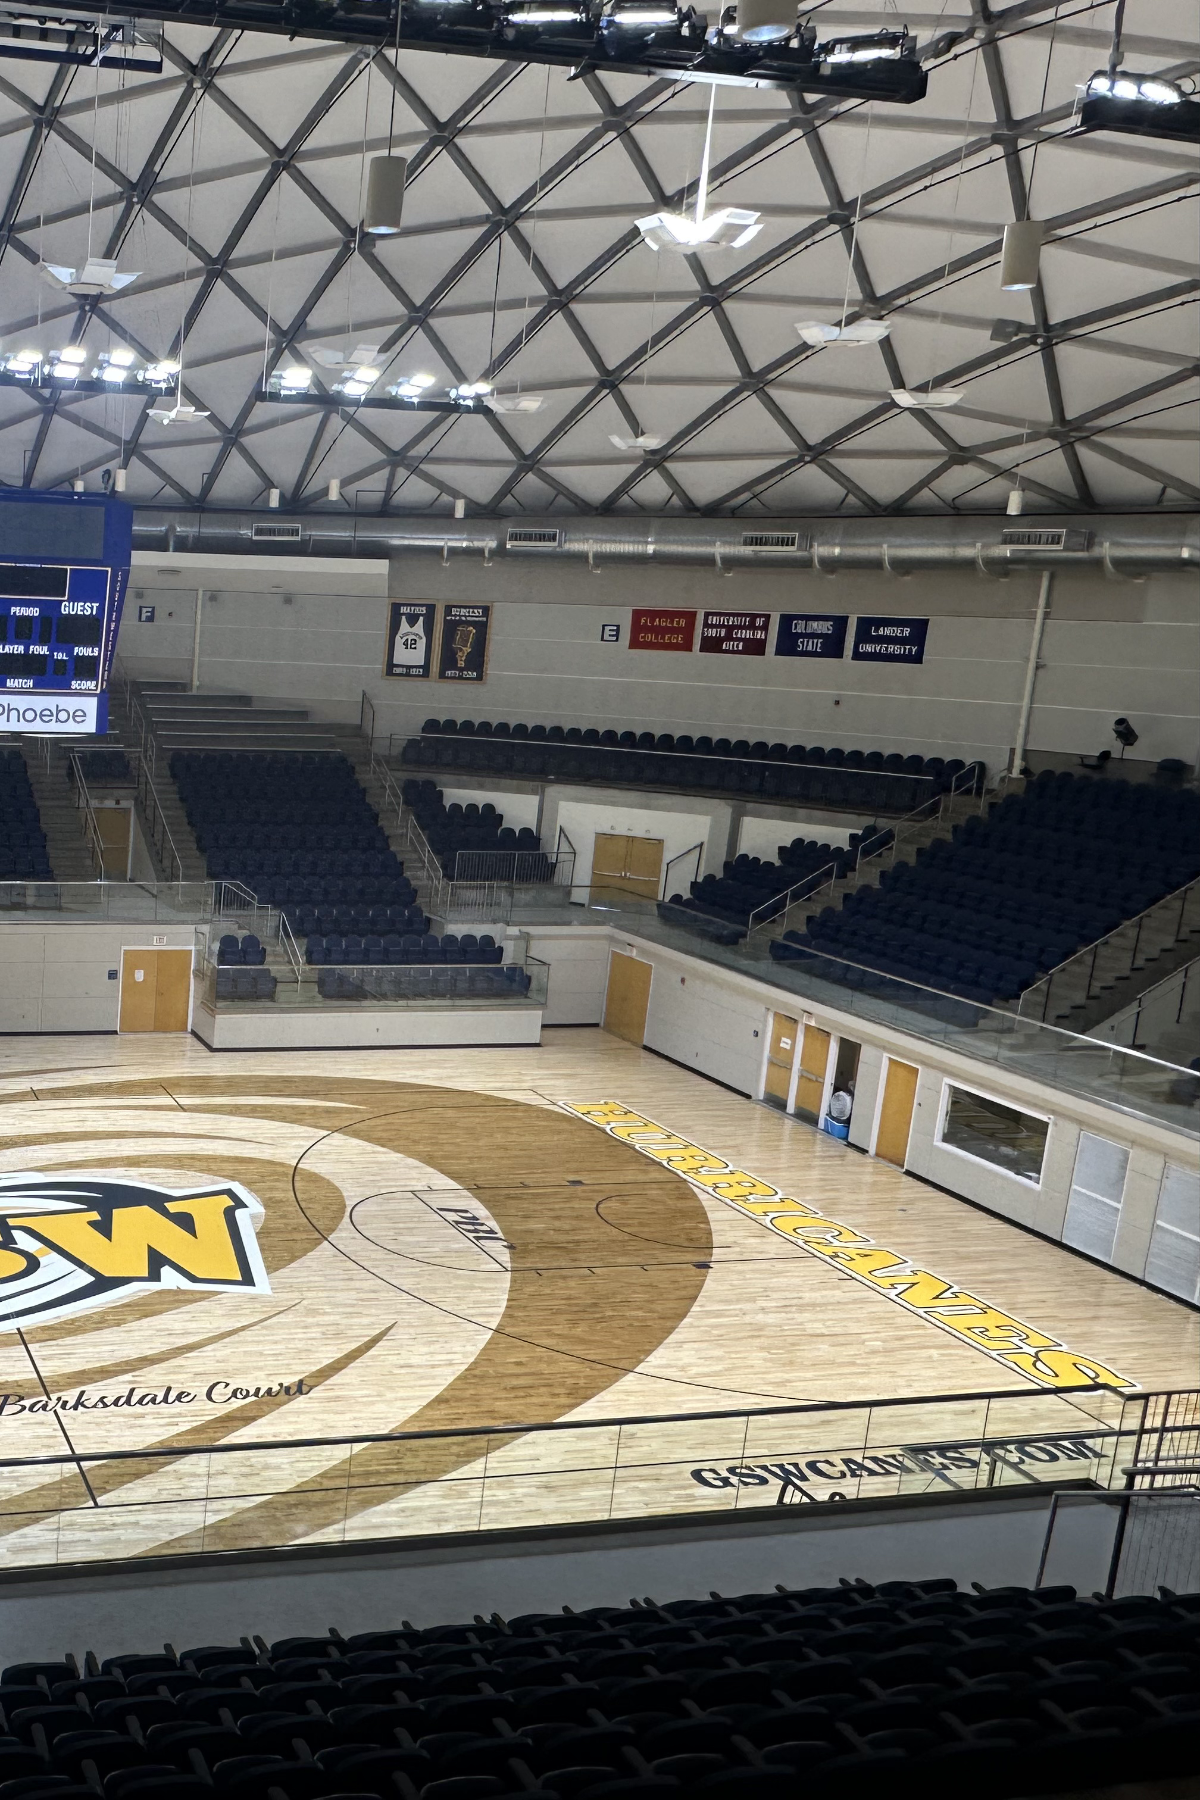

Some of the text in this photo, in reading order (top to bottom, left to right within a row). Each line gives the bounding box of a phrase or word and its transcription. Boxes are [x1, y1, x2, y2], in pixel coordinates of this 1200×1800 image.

[10, 606, 40, 616] PERIOD
[61, 601, 100, 616] GUEST
[141, 607, 153, 622] F
[640, 617, 686, 628] FLAGLER
[791, 620, 834, 634] COLUMBUS
[603, 626, 617, 641] E
[871, 626, 911, 637] LANDER
[402, 638, 417, 650] 42
[639, 633, 684, 644] COLLEGE
[29, 645, 50, 655] FOUL
[797, 638, 824, 652] STATE
[859, 643, 918, 655] UNIVERSITY
[73, 647, 99, 656] FOULS
[6, 678, 33, 688] MATCH
[70, 680, 97, 690] SCORE
[562, 1099, 1140, 1392] HURRICANES
[205, 1378, 314, 1404] Court
